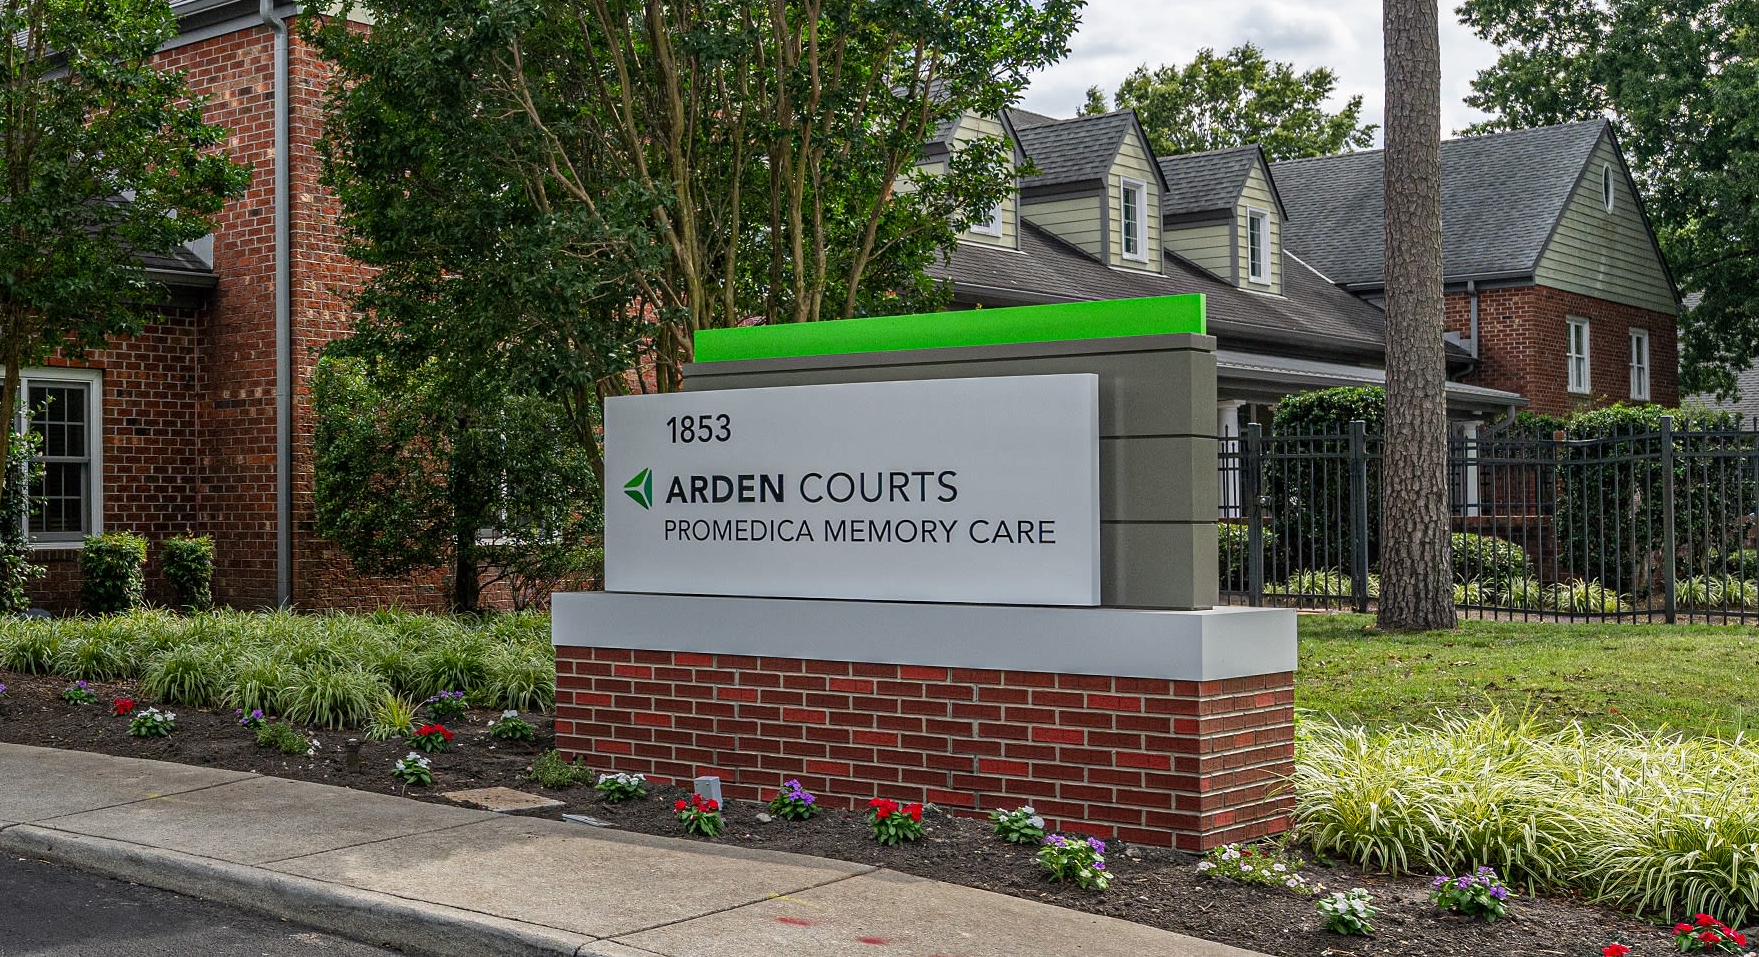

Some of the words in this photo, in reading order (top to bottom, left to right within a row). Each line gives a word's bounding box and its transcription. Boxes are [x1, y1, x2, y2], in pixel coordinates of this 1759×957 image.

[666, 413, 732, 444] 1853
[665, 473, 785, 504] ARDEN
[798, 470, 959, 504] COURTS
[664, 519, 815, 542] PROMEDICA
[824, 519, 959, 544] MEMORY
[968, 519, 1057, 545] CARE
